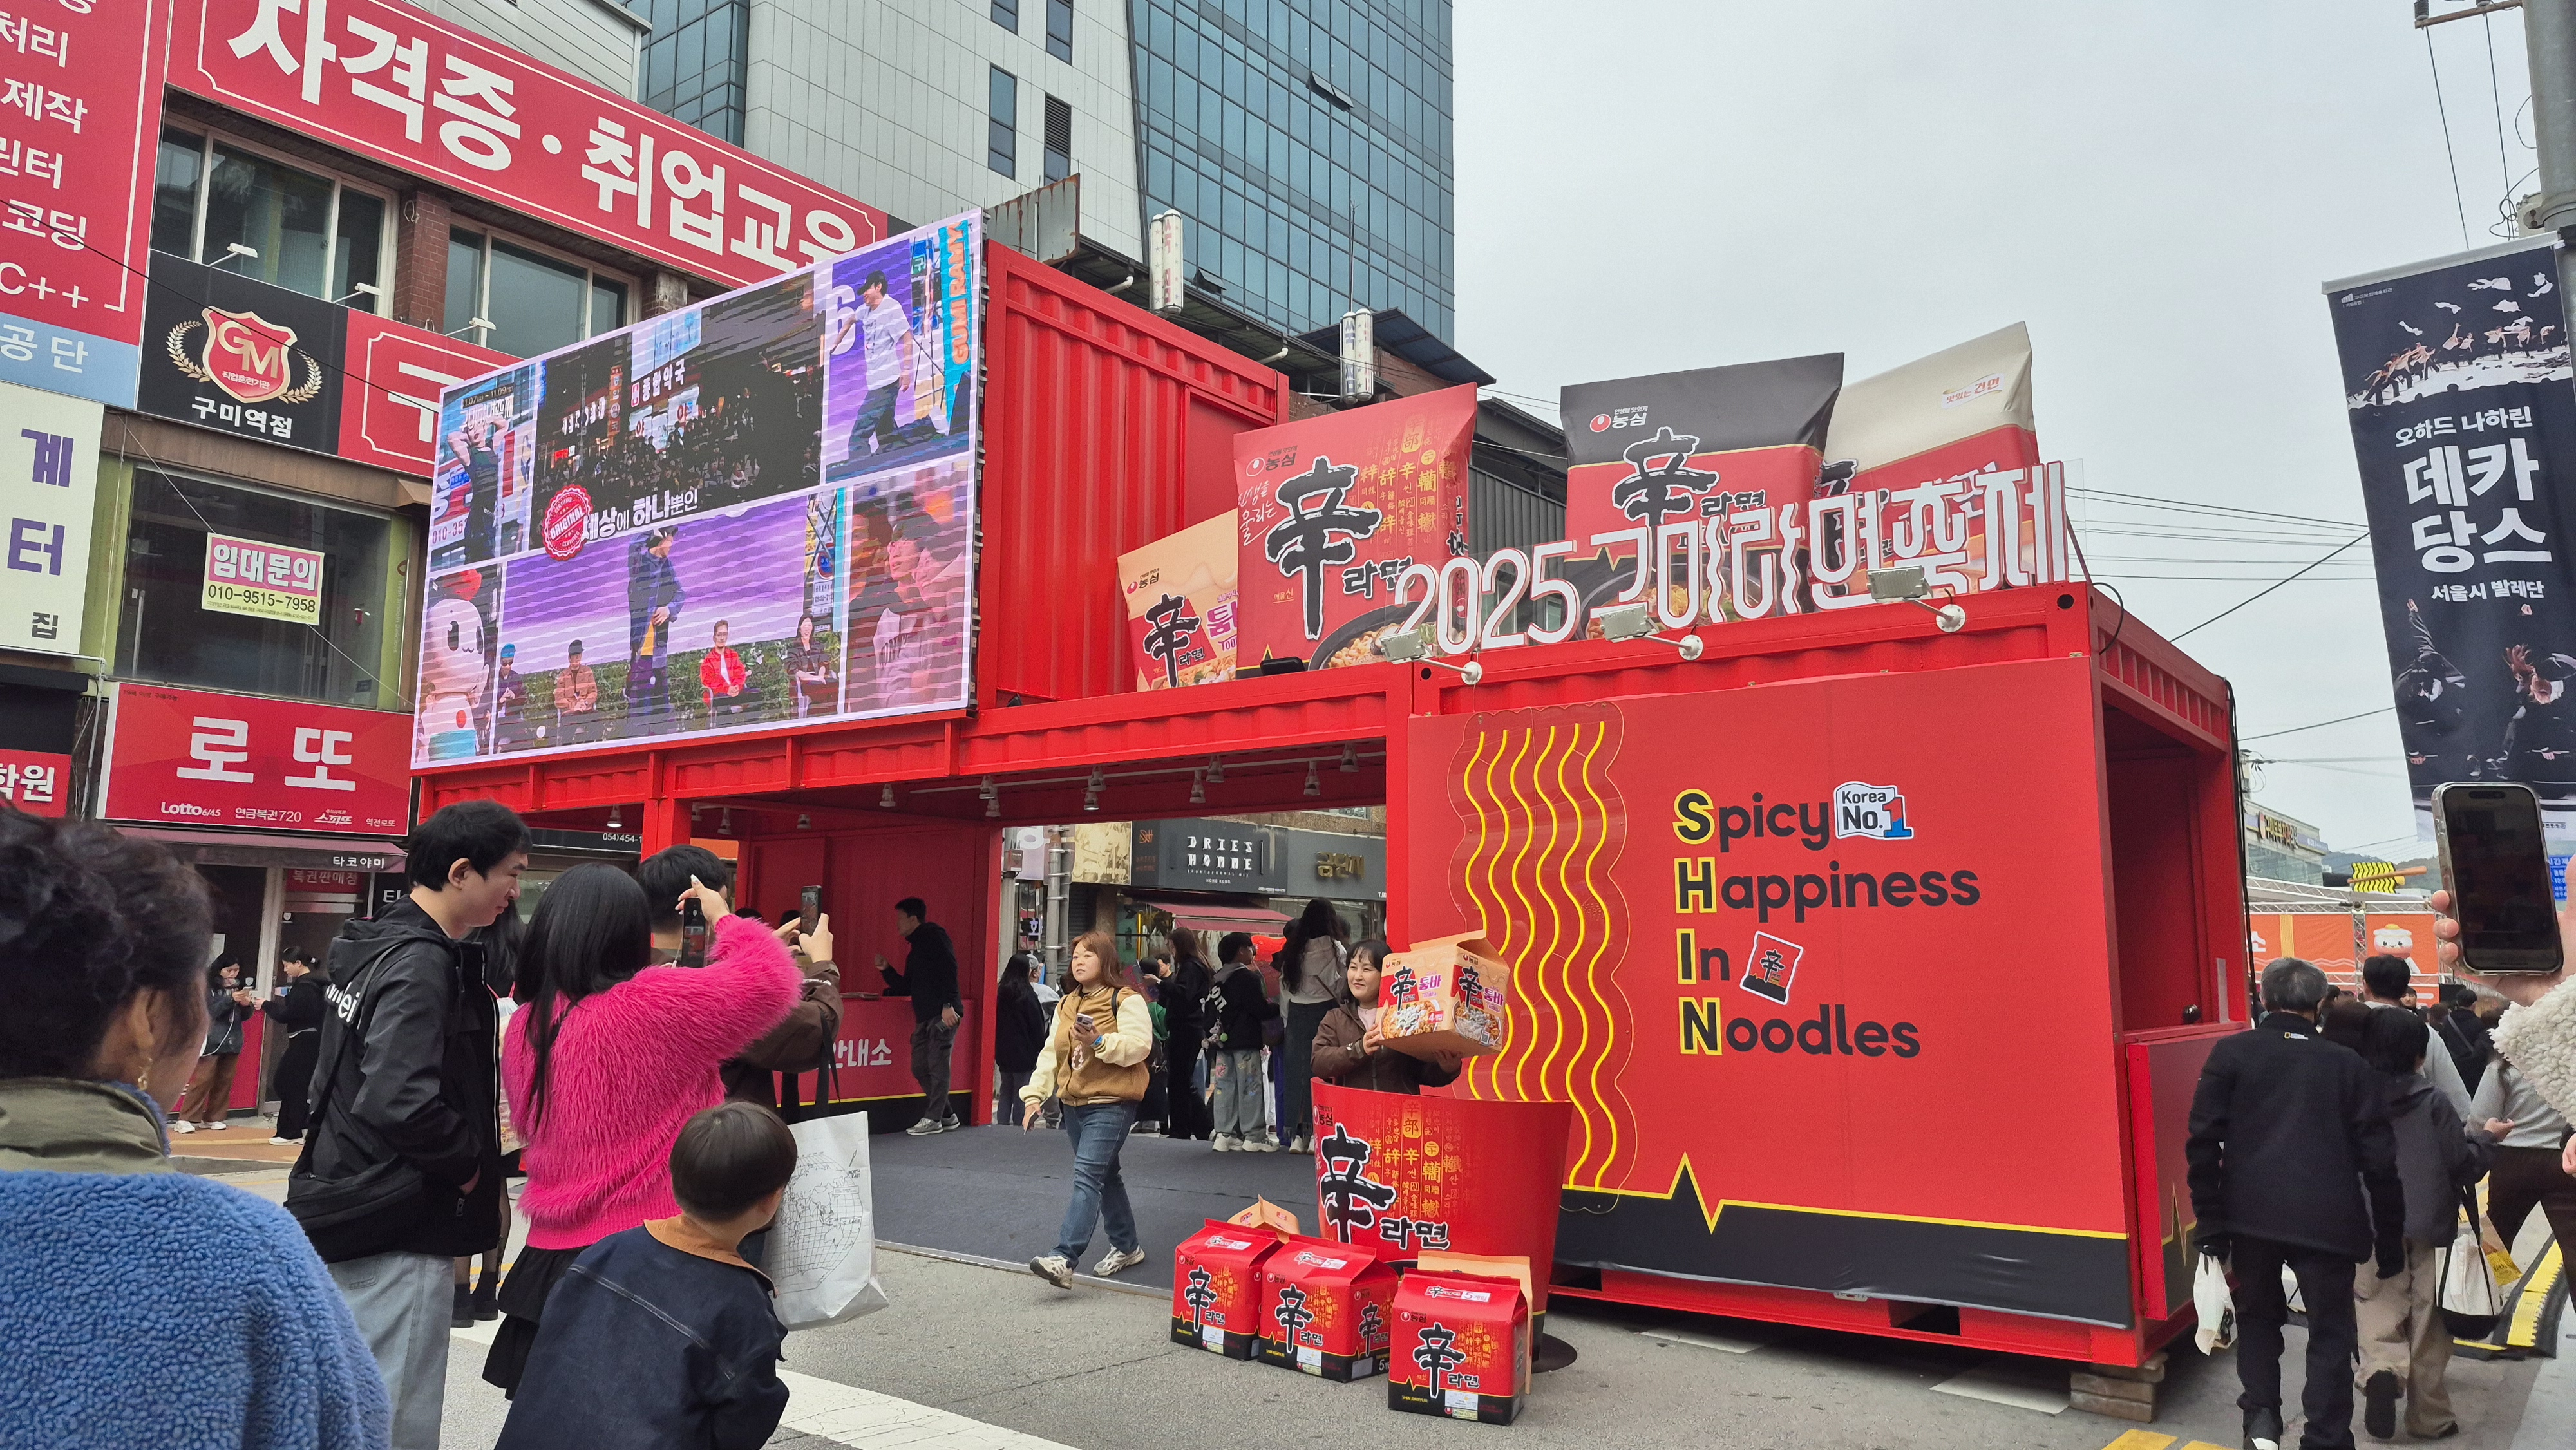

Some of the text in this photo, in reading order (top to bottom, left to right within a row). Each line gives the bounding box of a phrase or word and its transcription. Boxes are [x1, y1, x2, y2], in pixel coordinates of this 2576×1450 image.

[1, 78, 88, 134] 제작
[2, 198, 86, 250] 코딩
[0, 325, 88, 373] 공단
[217, 321, 279, 379] GM
[1973, 377, 2000, 395] 건면
[192, 396, 292, 438] 구미역점
[1611, 412, 1647, 429] 농심
[2395, 406, 2533, 447] 오하드 나하린
[21, 428, 74, 487] 계
[1265, 453, 1296, 471] 농심
[1611, 425, 1720, 528] 辛
[2403, 438, 2540, 507] 데카
[549, 505, 586, 540] ORIGINAL
[632, 489, 699, 526] 하나뿐인
[1700, 488, 1766, 522] 라면
[7, 518, 65, 576] 터
[1266, 455, 1383, 640] 辛
[1394, 539, 1580, 657] 2025
[1589, 460, 2069, 630] 구미라면축제
[2411, 507, 2553, 573] 당스
[213, 544, 317, 591] 임대문의
[1139, 572, 1160, 589] 농심
[1341, 554, 1416, 599] 라면
[208, 584, 316, 613] 010-9515-7958
[2431, 579, 2545, 602] 서울시 발레단
[32, 612, 59, 640] 집
[1143, 592, 1202, 688] 辛
[1178, 646, 1206, 666] 라면
[176, 716, 358, 792] 로또
[234, 807, 302, 823] 연금복권720
[1841, 791, 1887, 804] Korea
[603, 833, 643, 843] 054)454-1
[1673, 788, 1830, 853] Spicy
[332, 856, 384, 869] 타코야미
[1187, 836, 1253, 854] DRIES
[1187, 853, 1253, 871] HOMME
[292, 869, 358, 886] 복권판매점
[1674, 857, 1981, 923] Happiness
[1676, 928, 1730, 985] In
[1390, 965, 1417, 1012] 辛
[1419, 974, 1442, 991] 툼바
[1458, 965, 1484, 1008] 辛
[1483, 986, 1504, 1007] 툼바
[1678, 996, 1921, 1059] Noodles
[1321, 1122, 1397, 1245] 辛
[1379, 1215, 1451, 1251] 라면
[1184, 1265, 1218, 1333] 辛
[1205, 1310, 1225, 1325] 라면
[1274, 1283, 1314, 1354] 辛
[1300, 1330, 1323, 1346] 라면
[1358, 1301, 1384, 1357] 辛
[1412, 1321, 1466, 1399] 辛
[1447, 1372, 1480, 1389] 라면
